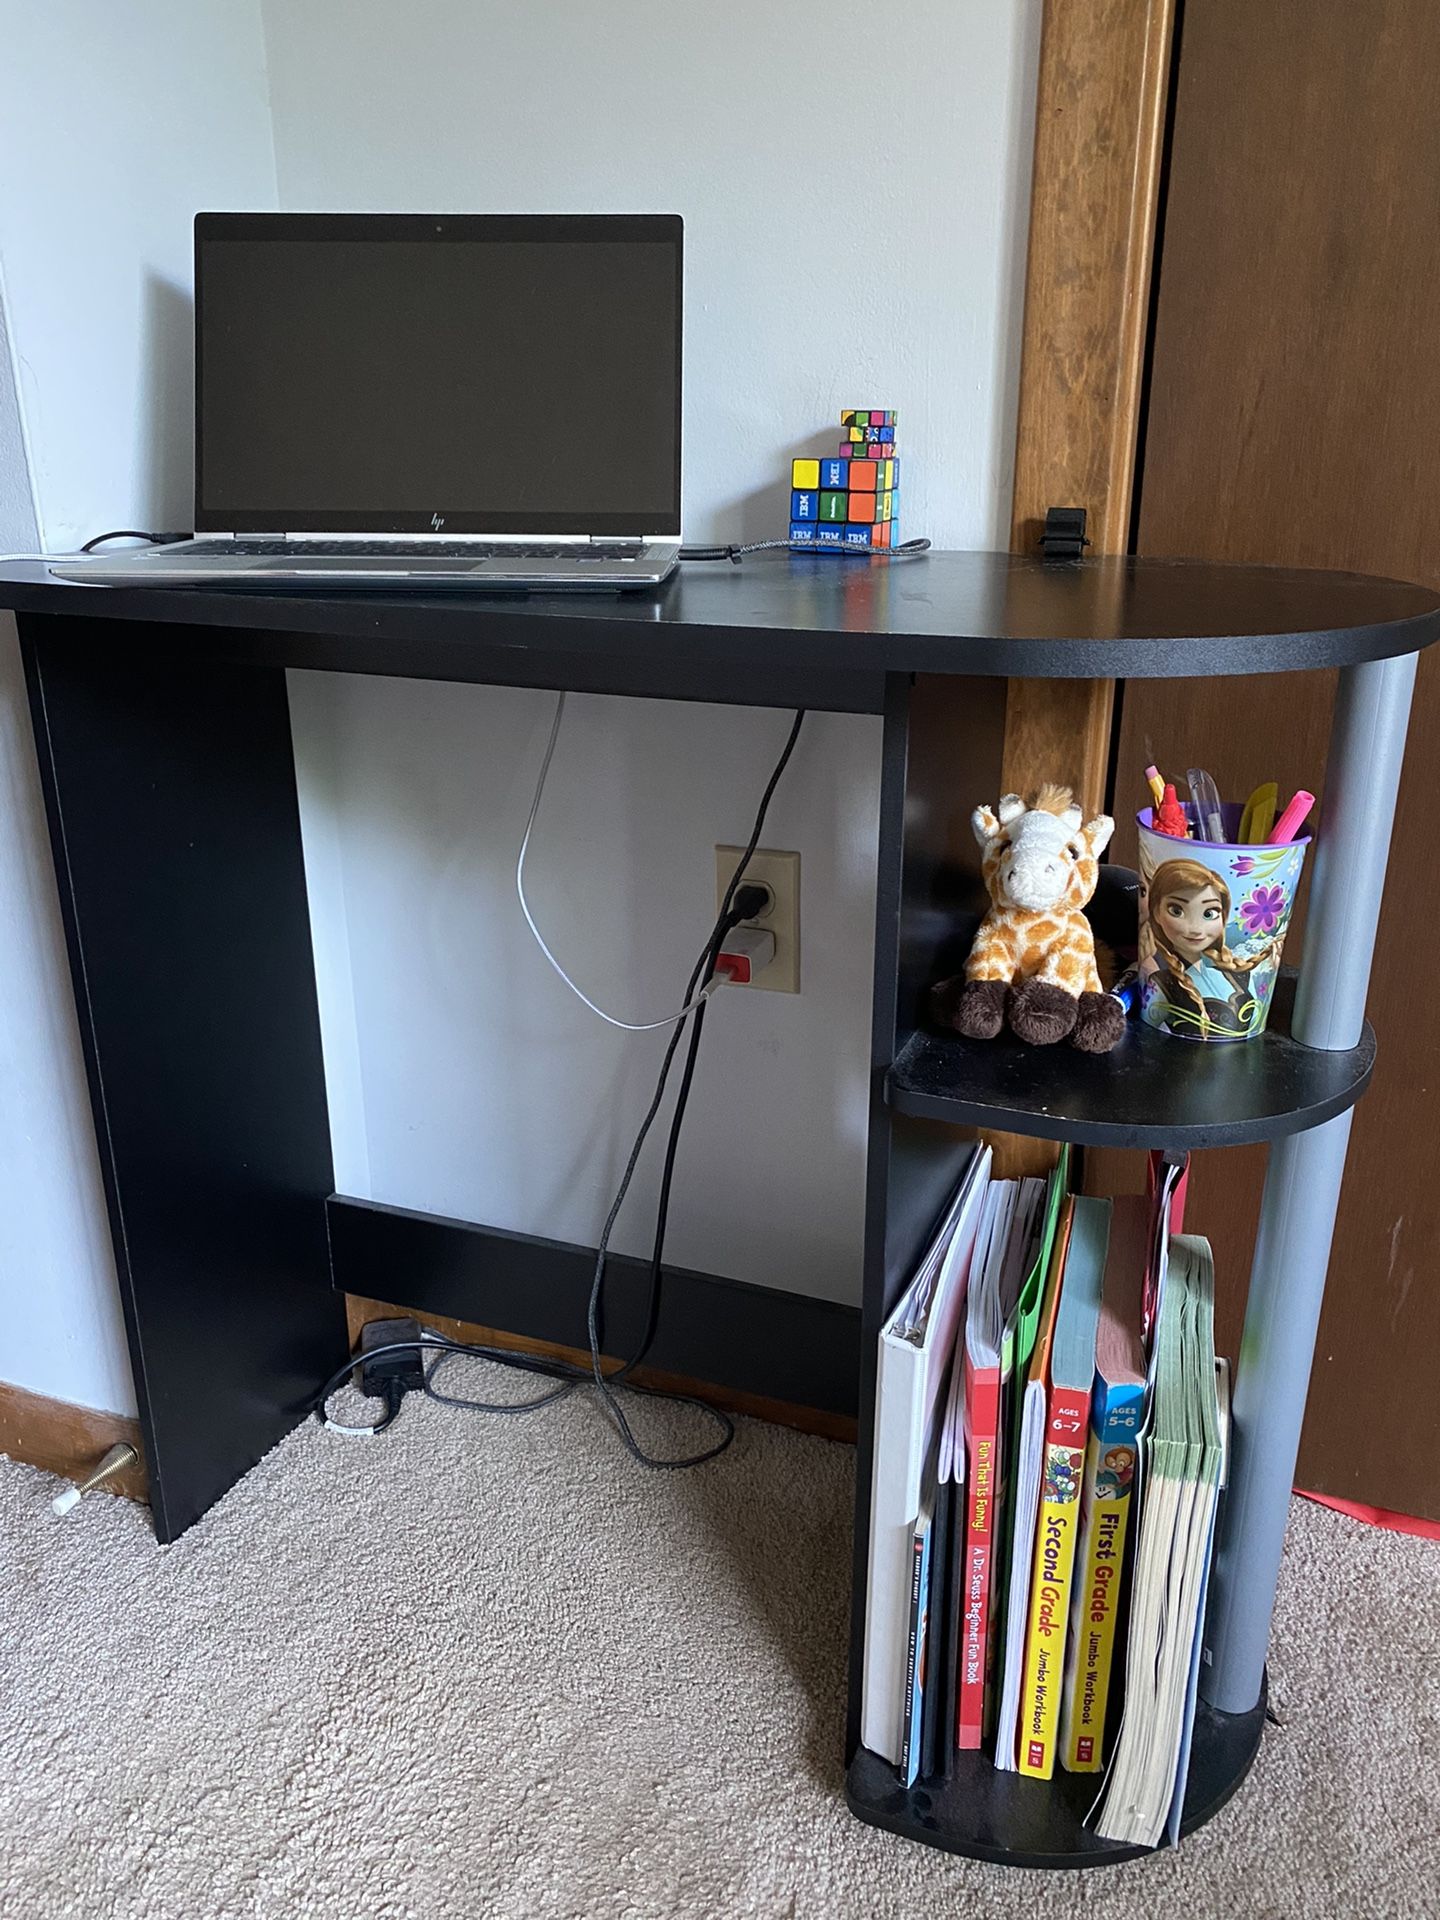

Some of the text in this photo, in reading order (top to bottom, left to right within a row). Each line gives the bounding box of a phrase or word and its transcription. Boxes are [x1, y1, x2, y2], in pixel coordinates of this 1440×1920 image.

[829, 462, 840, 485] IBM
[430, 512, 445, 532] hp
[799, 494, 809, 517] IBM
[847, 533, 868, 544] IBM
[1052, 1418, 1081, 1433] 6-7
[1058, 1407, 1080, 1417] AGES
[1108, 1416, 1135, 1427] 5-6
[1111, 1407, 1137, 1415] AGES
[971, 1441, 993, 1532] Fun That Is Funny!
[1042, 1516, 1067, 1584] Second
[1095, 1513, 1120, 1560] First
[1038, 1586, 1060, 1637] Grade
[1090, 1565, 1114, 1623] Grade
[965, 1547, 985, 1685] A Dr. Seuss Beginner Fun Book
[1037, 1648, 1051, 1683] Jumbo
[1087, 1631, 1102, 1667] Jumbo
[1033, 1685, 1047, 1735] Workbook
[1082, 1671, 1098, 1725] Workbook
